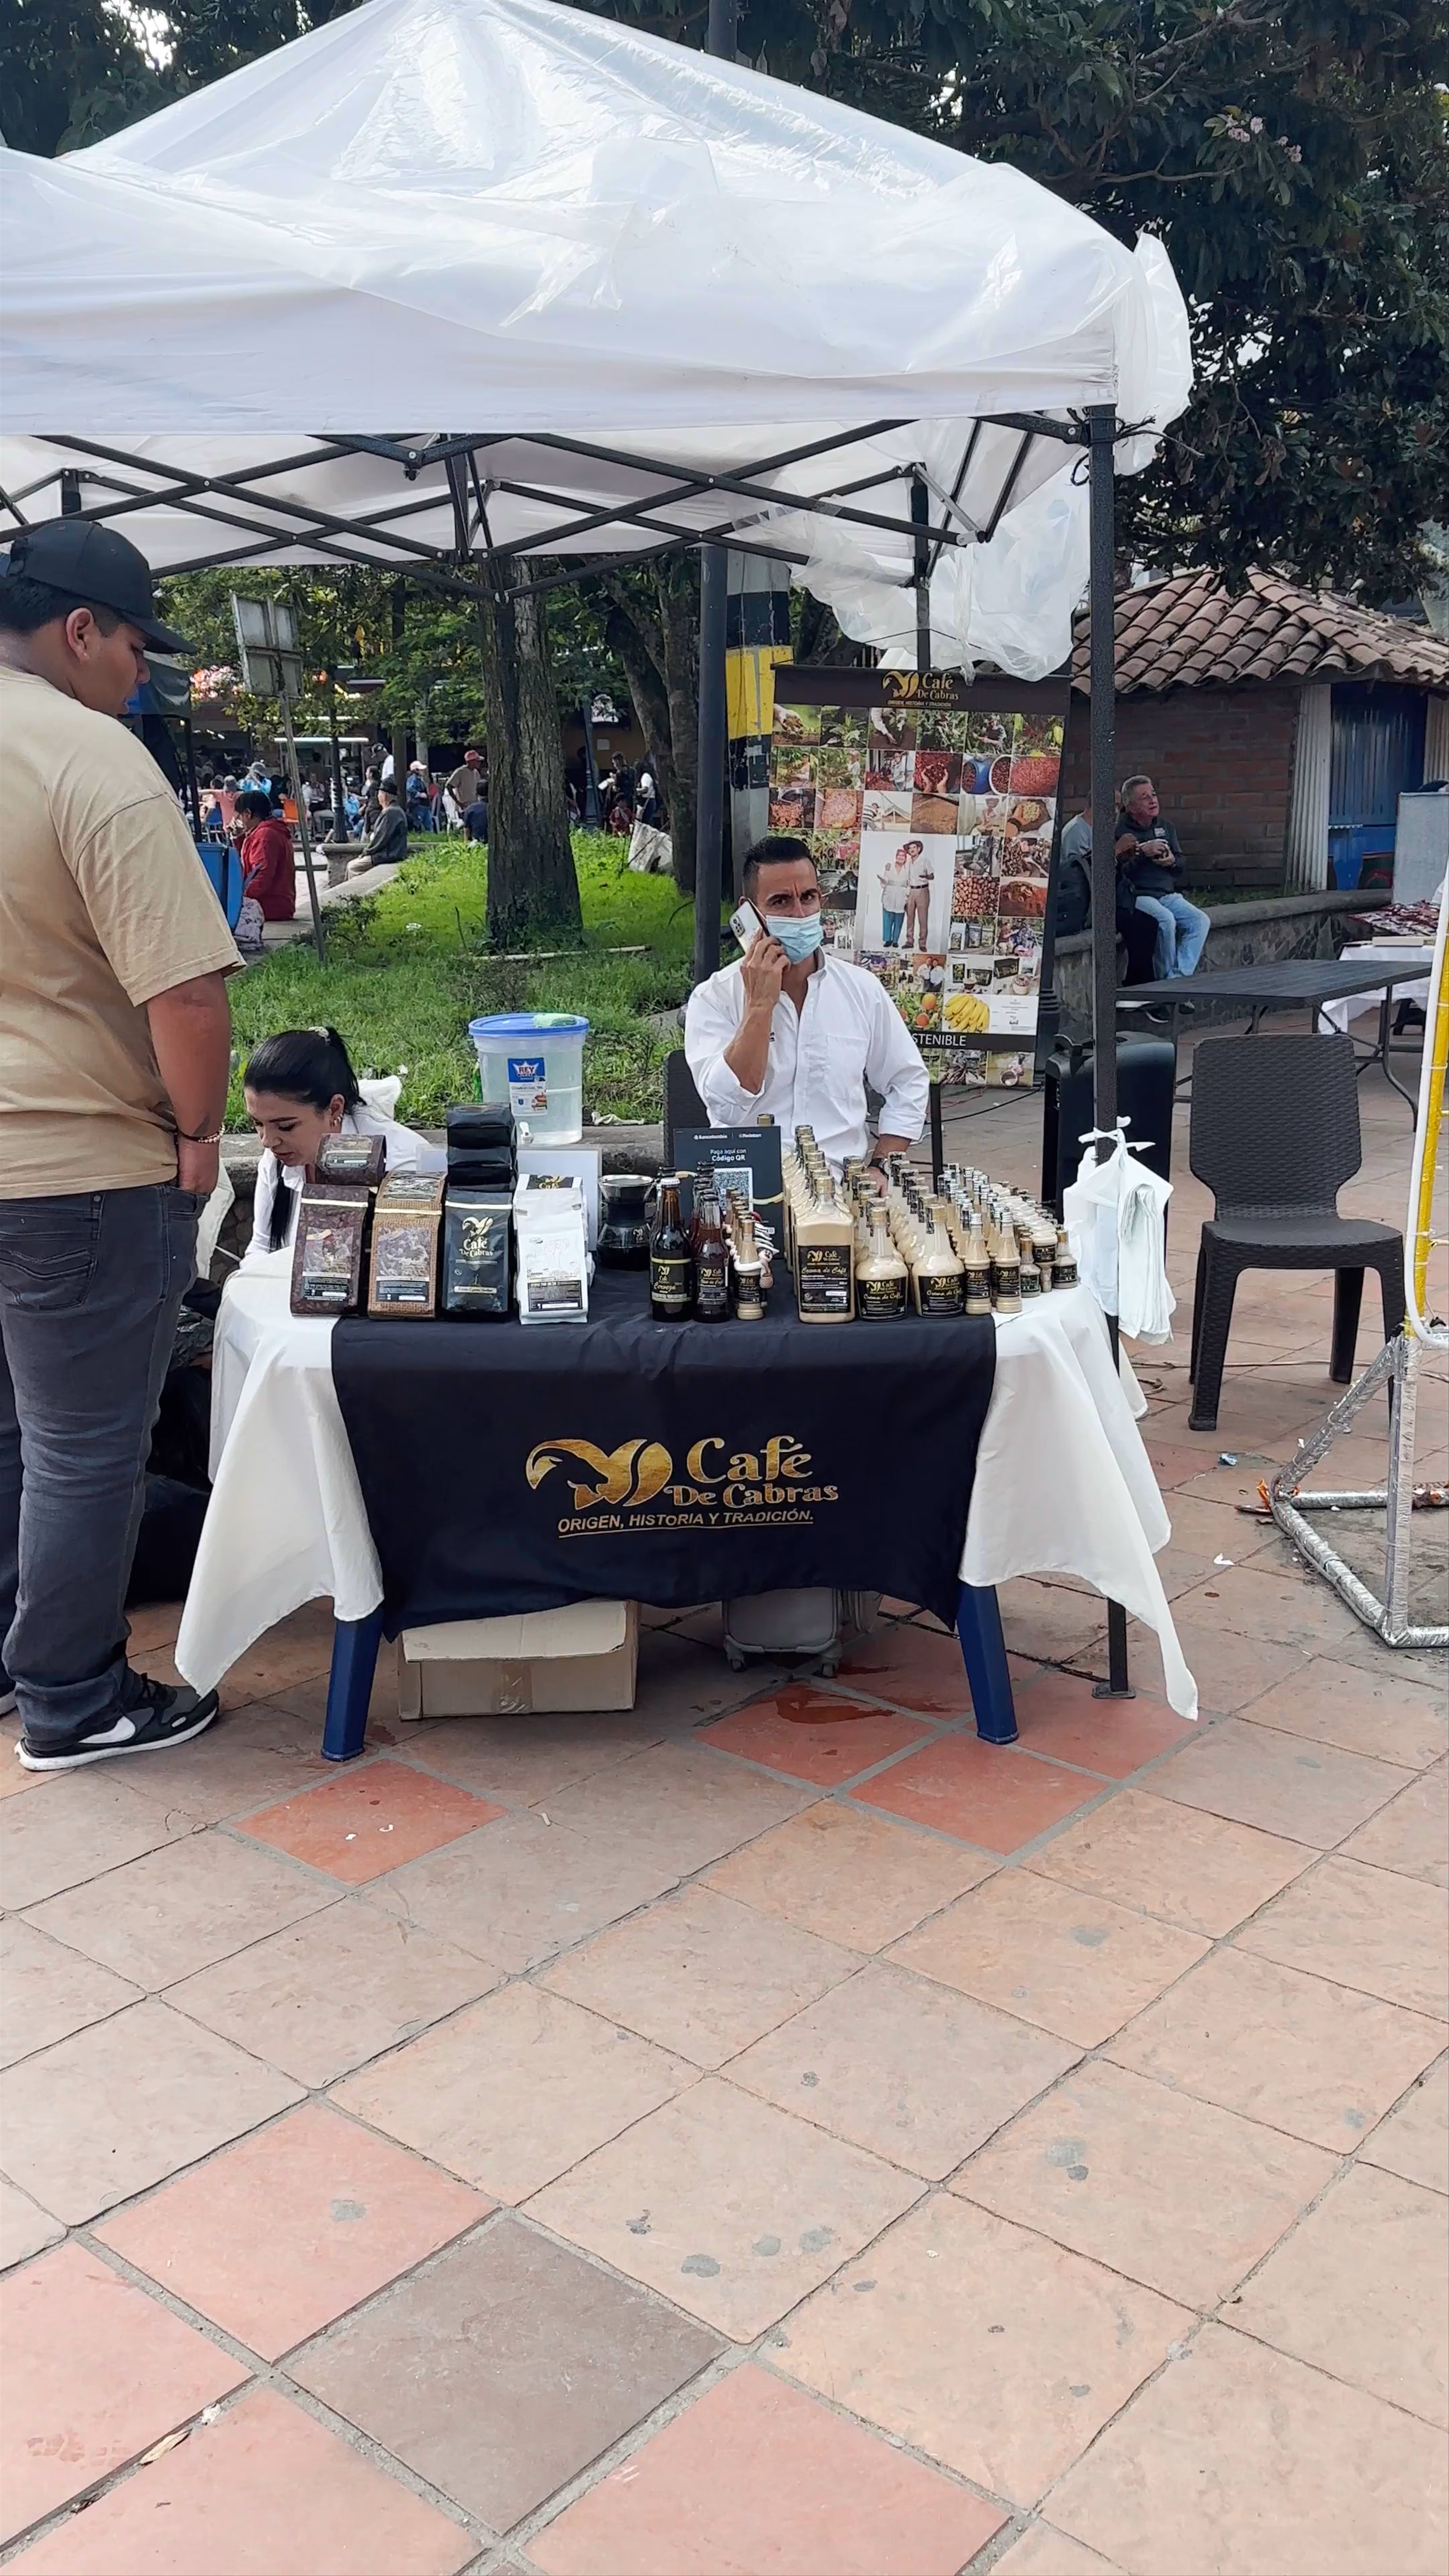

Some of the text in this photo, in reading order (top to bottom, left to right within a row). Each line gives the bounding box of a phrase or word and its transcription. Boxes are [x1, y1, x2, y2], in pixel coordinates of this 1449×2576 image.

[922, 672, 954, 690] Café
[916, 689, 959, 700] De Cabras
[463, 1236, 488, 1250] Café
[687, 1435, 813, 1483] Café
[663, 1483, 839, 1509] De Cabras
[558, 1508, 814, 1533] ORIGEN, HISTORIA Y TRADICIÓN.
